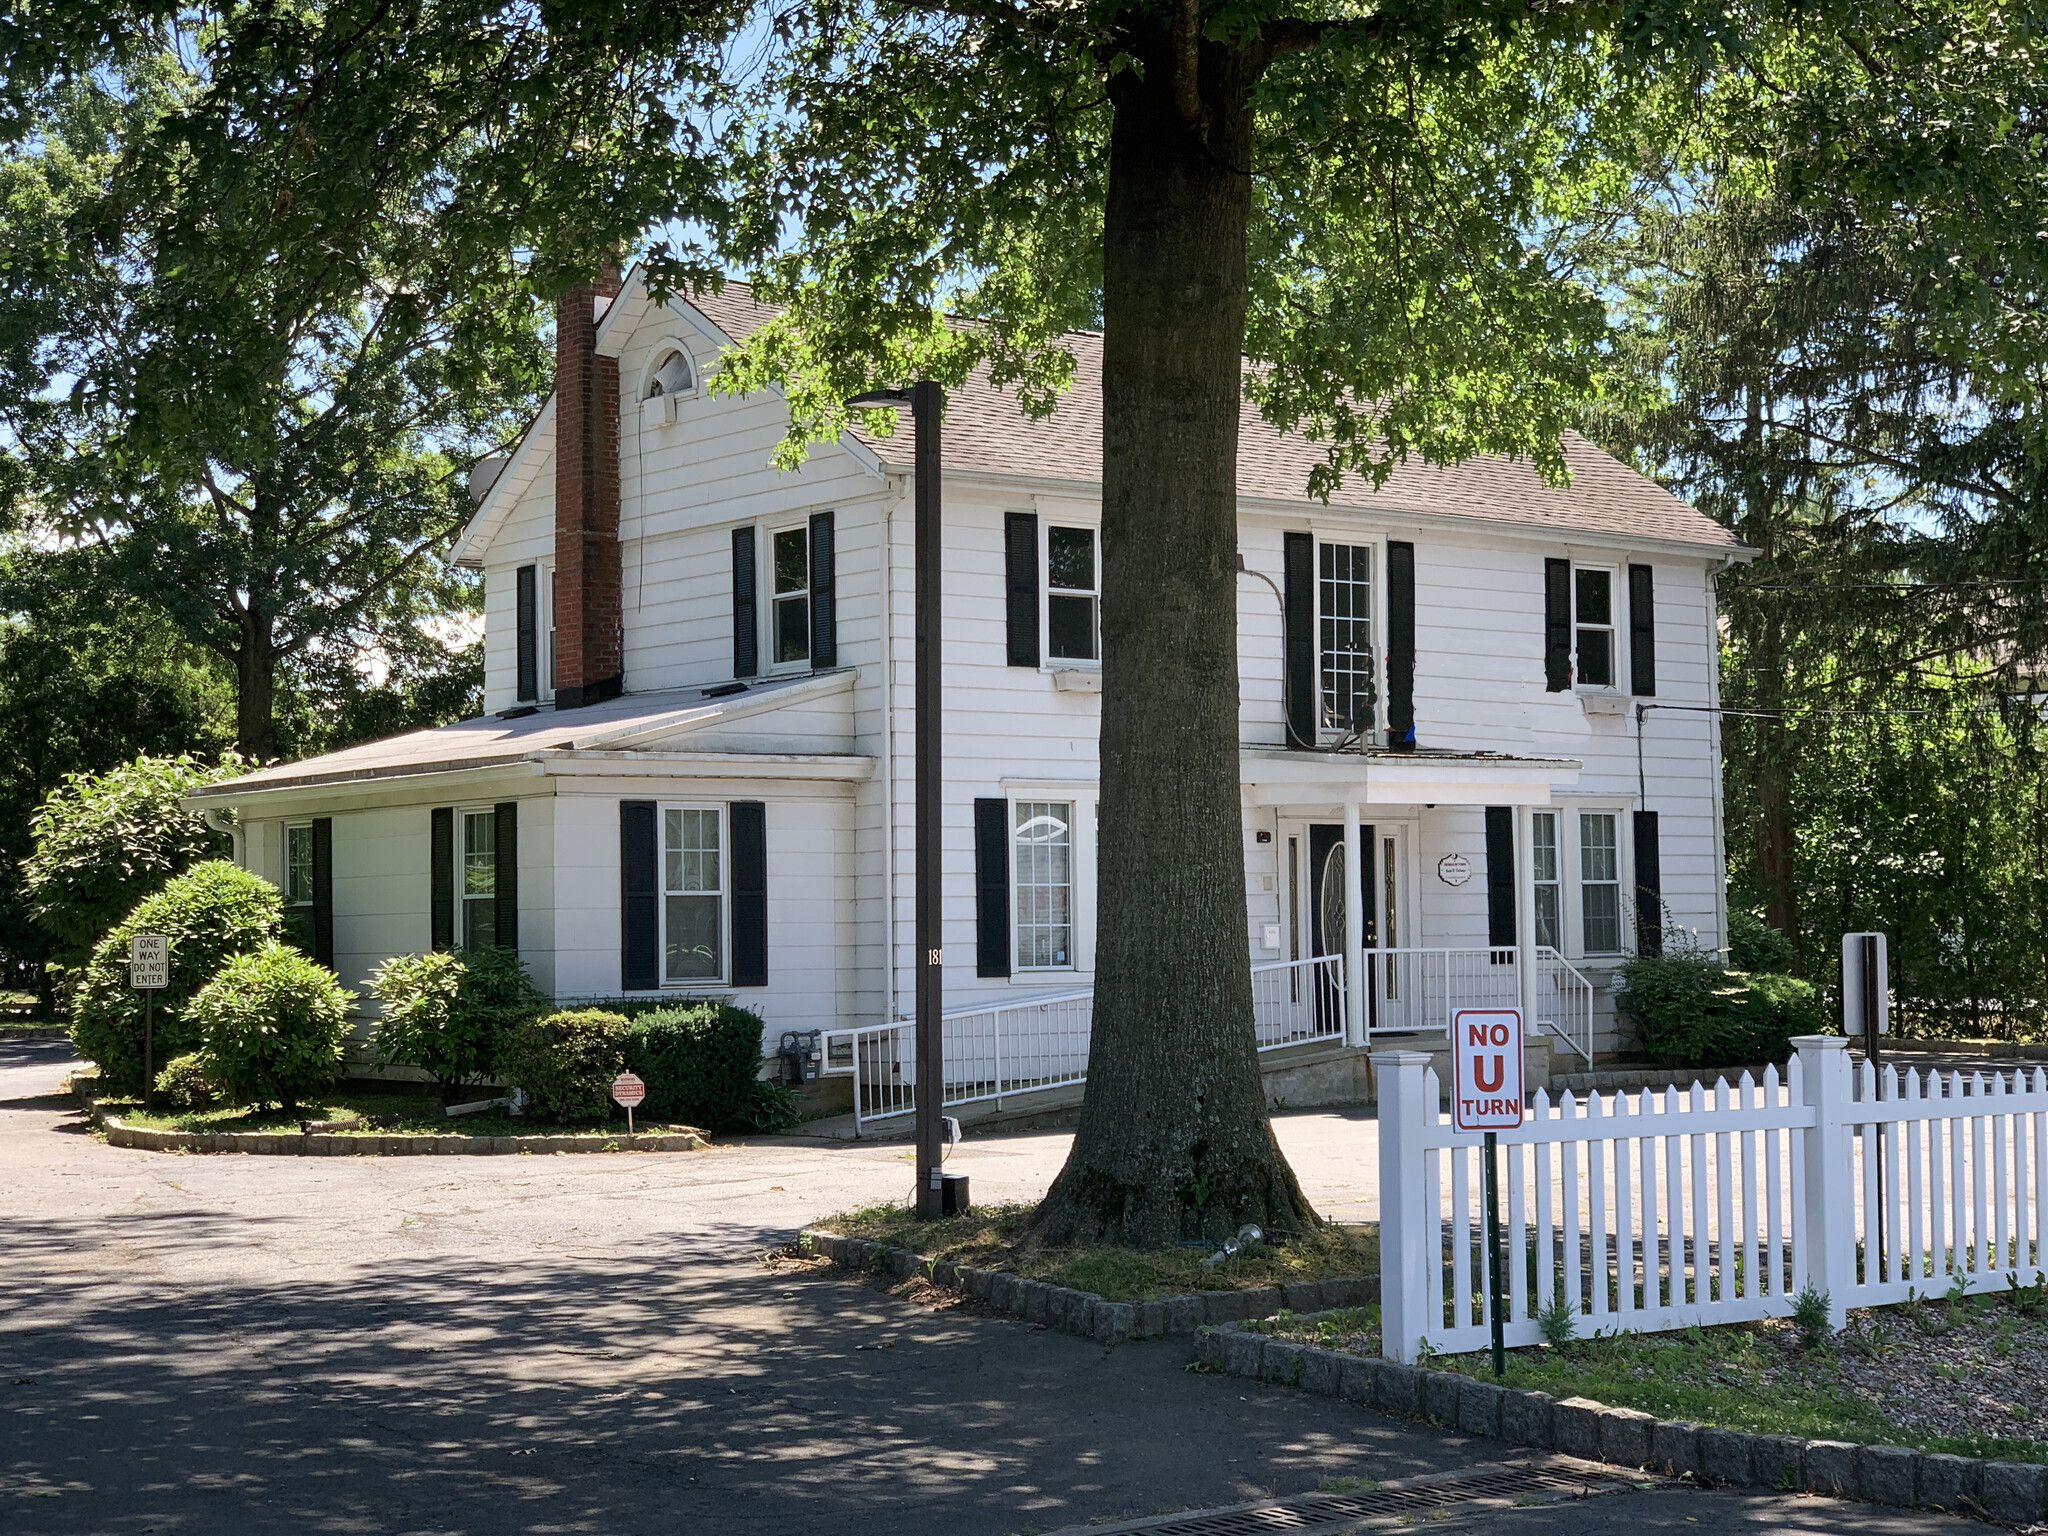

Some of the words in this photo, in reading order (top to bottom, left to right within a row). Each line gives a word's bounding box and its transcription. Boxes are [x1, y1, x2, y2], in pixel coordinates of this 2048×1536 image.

[140, 939, 159, 949] ONE
[139, 951, 160, 960] WAY
[928, 949, 942, 965] 181
[134, 963, 145, 972] DO
[149, 963, 165, 972] NOT
[136, 975, 163, 984] ENTER
[1469, 1024, 1510, 1046] NO
[1473, 1055, 1504, 1093] U
[1462, 1099, 1519, 1116] TURN
